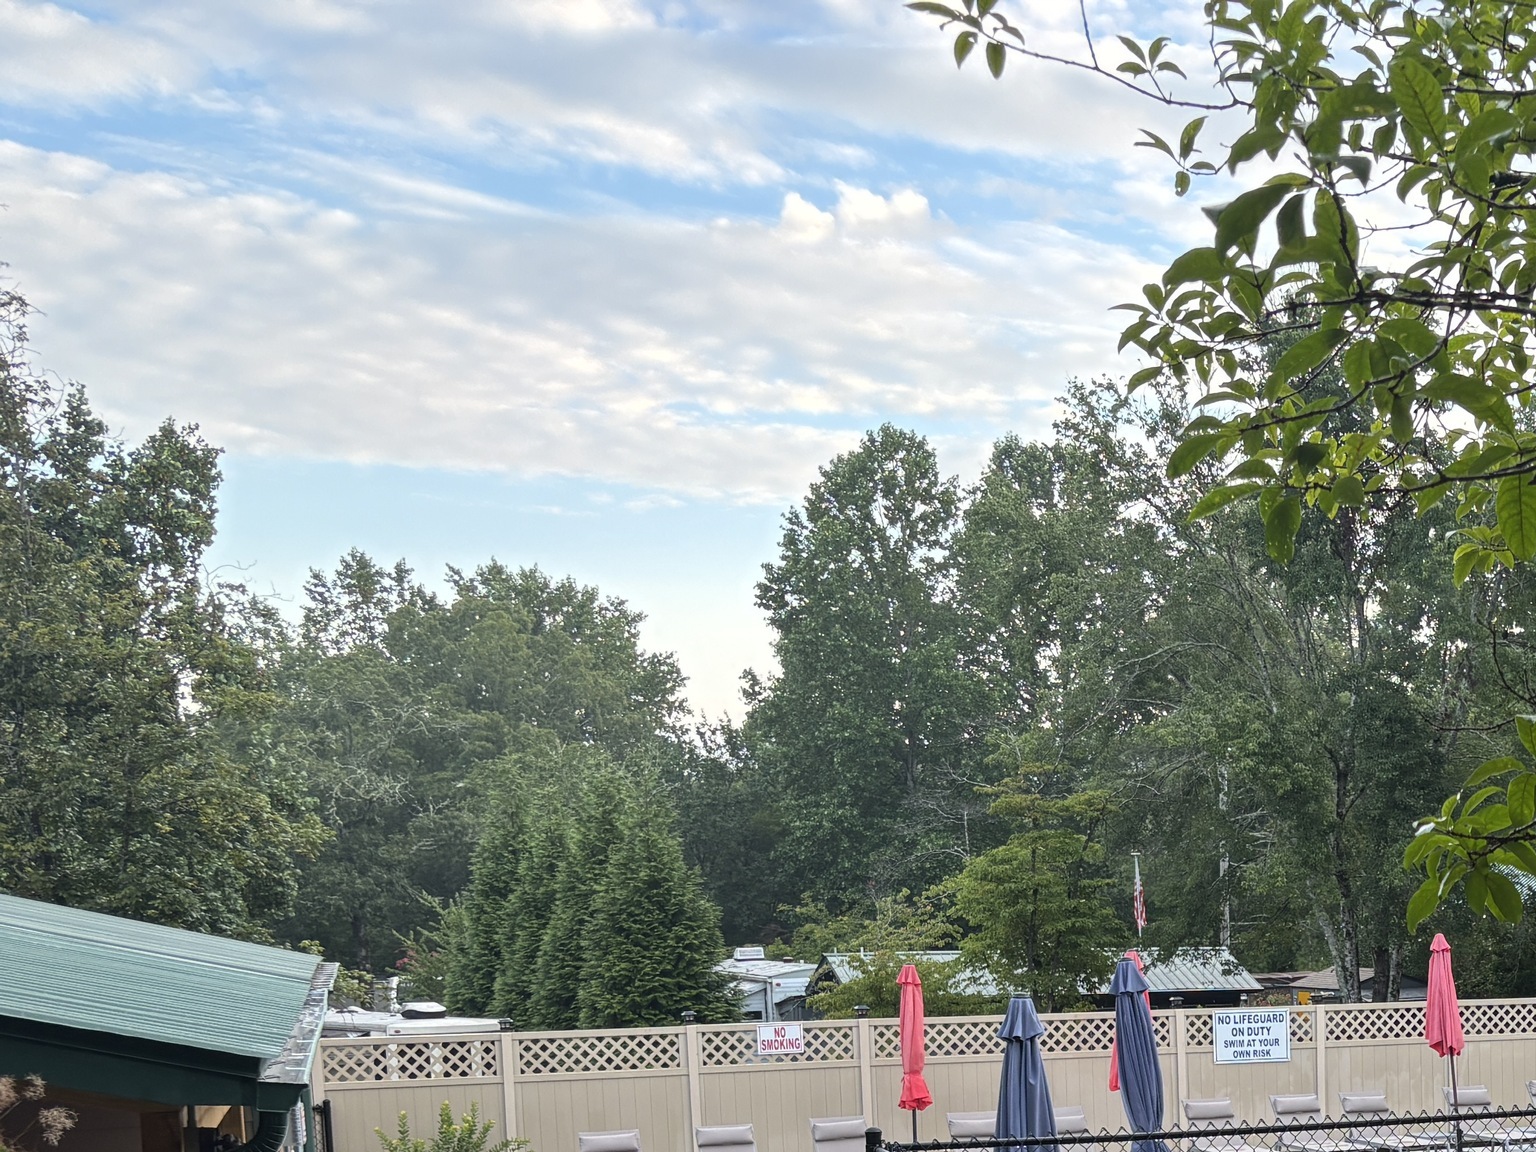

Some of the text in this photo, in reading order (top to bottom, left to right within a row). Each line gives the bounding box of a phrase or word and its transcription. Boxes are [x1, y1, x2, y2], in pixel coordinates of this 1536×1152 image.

[1218, 1013, 1284, 1025] NO LIFEGUARD
[774, 1027, 786, 1038] NO
[1231, 1026, 1271, 1037] ON DUTY
[761, 1038, 800, 1051] SMOKING
[1224, 1038, 1280, 1048] SWIM AT YOUR
[1233, 1049, 1271, 1058] OWN RISK
